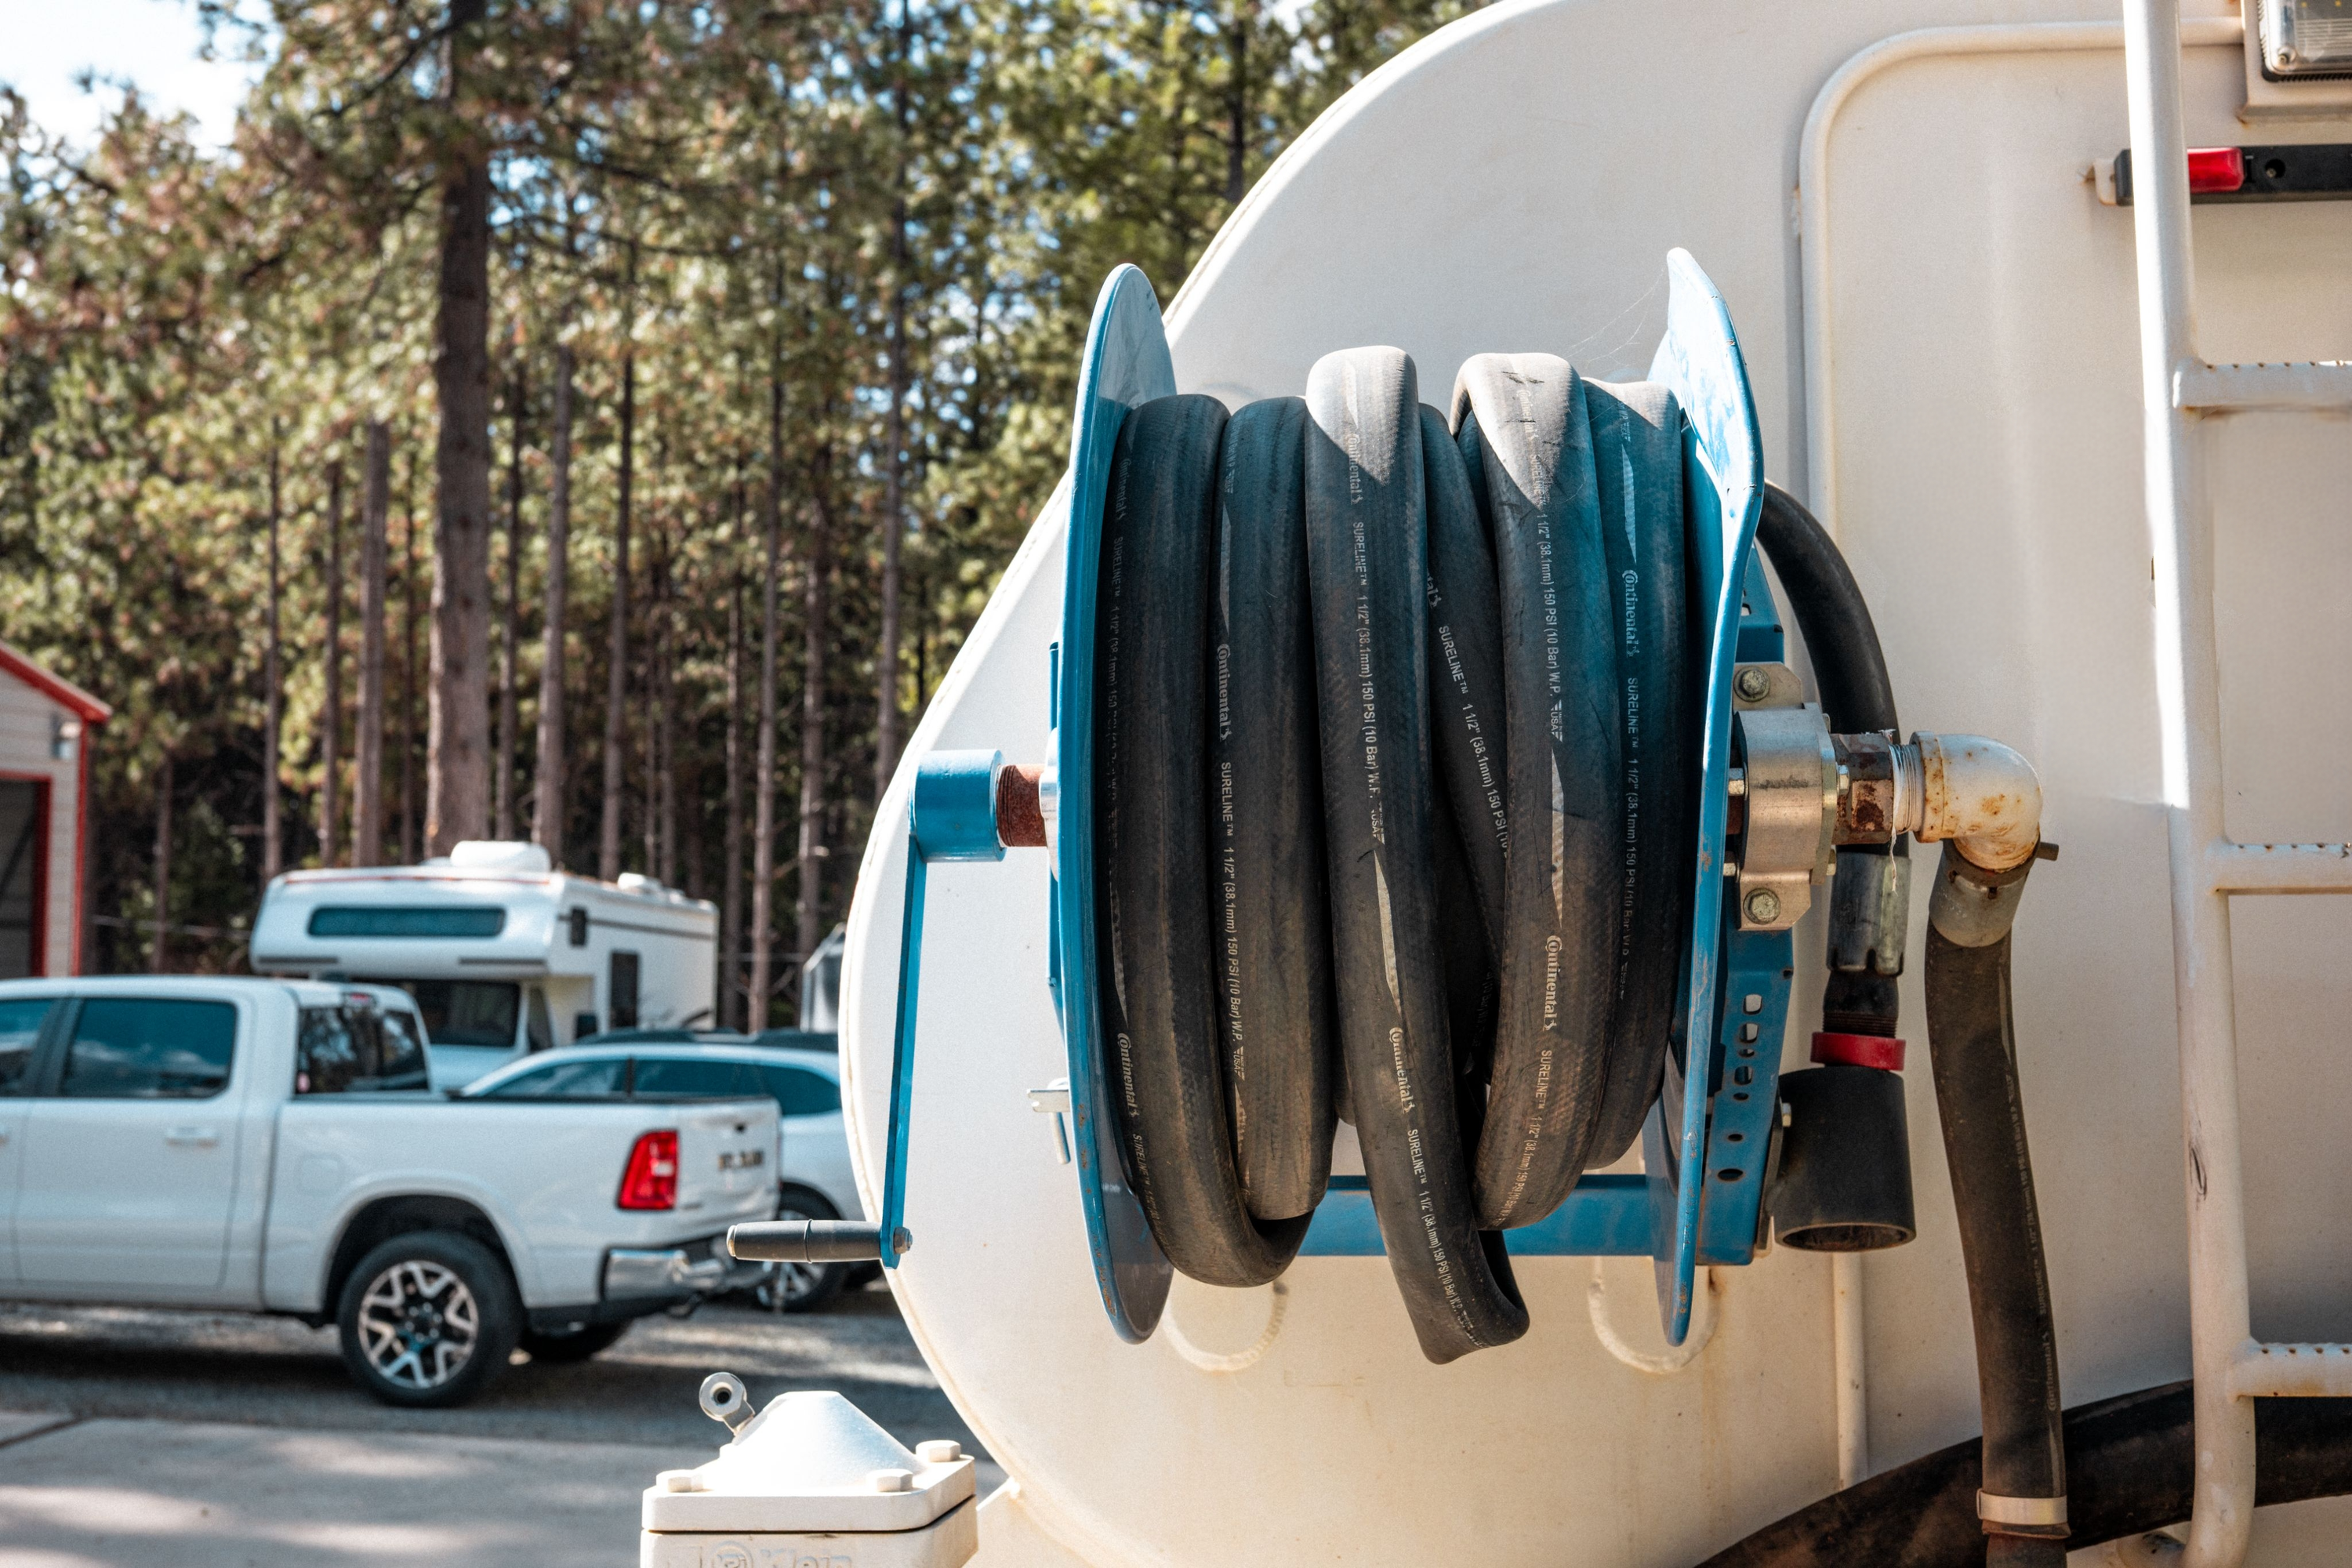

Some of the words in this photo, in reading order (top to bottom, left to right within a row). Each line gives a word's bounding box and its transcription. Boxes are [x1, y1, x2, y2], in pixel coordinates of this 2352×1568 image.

[1346, 434, 1363, 493] Continental
[1116, 459, 1131, 511] Continental
[1538, 521, 1550, 539] 1/2"
[1353, 521, 1367, 586] SURELINE™
[1537, 541, 1554, 585] (38.1mm)
[1111, 536, 1124, 597] SURELINE™
[1543, 587, 1555, 605] 150
[1358, 604, 1370, 624] 1/2"
[1545, 608, 1557, 625] PSI
[1621, 569, 1639, 645] Continental
[1544, 628, 1559, 644] (10
[1106, 637, 1120, 686] (38.1mm)
[1356, 627, 1372, 677] (38.1mm)
[1439, 626, 1468, 694] SURELINE™
[1546, 647, 1560, 669] Bar)
[1217, 644, 1231, 727] Continental
[1361, 681, 1374, 700] 150
[1549, 672, 1561, 696] W.P.
[1107, 689, 1118, 707] 150
[1363, 703, 1376, 722] PSI
[1628, 677, 1639, 748] SURELINE™
[1362, 725, 1377, 742] (10
[1465, 713, 1481, 734] 1/2"
[1364, 746, 1379, 769] Bar)
[1470, 737, 1495, 788] (38.1mm)
[1628, 768, 1639, 789] 1/2"
[1221, 762, 1233, 837] SURELINE™
[1486, 789, 1501, 808] 150
[1492, 810, 1507, 830] PSI
[1625, 792, 1639, 842] (38.1mm)
[1626, 846, 1636, 865] 150
[1224, 858, 1235, 879] 1/2"
[1624, 869, 1635, 887] PSI
[1223, 882, 1237, 933] (38.1mm)
[1227, 937, 1238, 955] 150
[1229, 957, 1240, 976] PSI
[1544, 935, 1563, 1018] Continental
[1227, 978, 1241, 994] (10
[1228, 996, 1242, 1018] Bar)
[1232, 1021, 1243, 1042] W.P.
[1117, 1033, 1138, 1107] Continental
[1535, 1050, 1552, 1109] SURELINE™
[1407, 1129, 1427, 1184] SURELINE™
[1519, 1139, 1538, 1171] (38.1mm)
[1510, 1182, 1525, 1192] PSI
[1515, 1171, 1528, 1182] 150
[1421, 1198, 1433, 1212] 1/2"
[1421, 1214, 1440, 1248] (38.1mm)
[1432, 1248, 1445, 1261] 150
[1436, 1261, 1450, 1274] PSI
[1438, 1274, 1451, 1284] (10
[1443, 1284, 1457, 1298] Bar)
[2042, 1341, 2057, 1410] Continental
